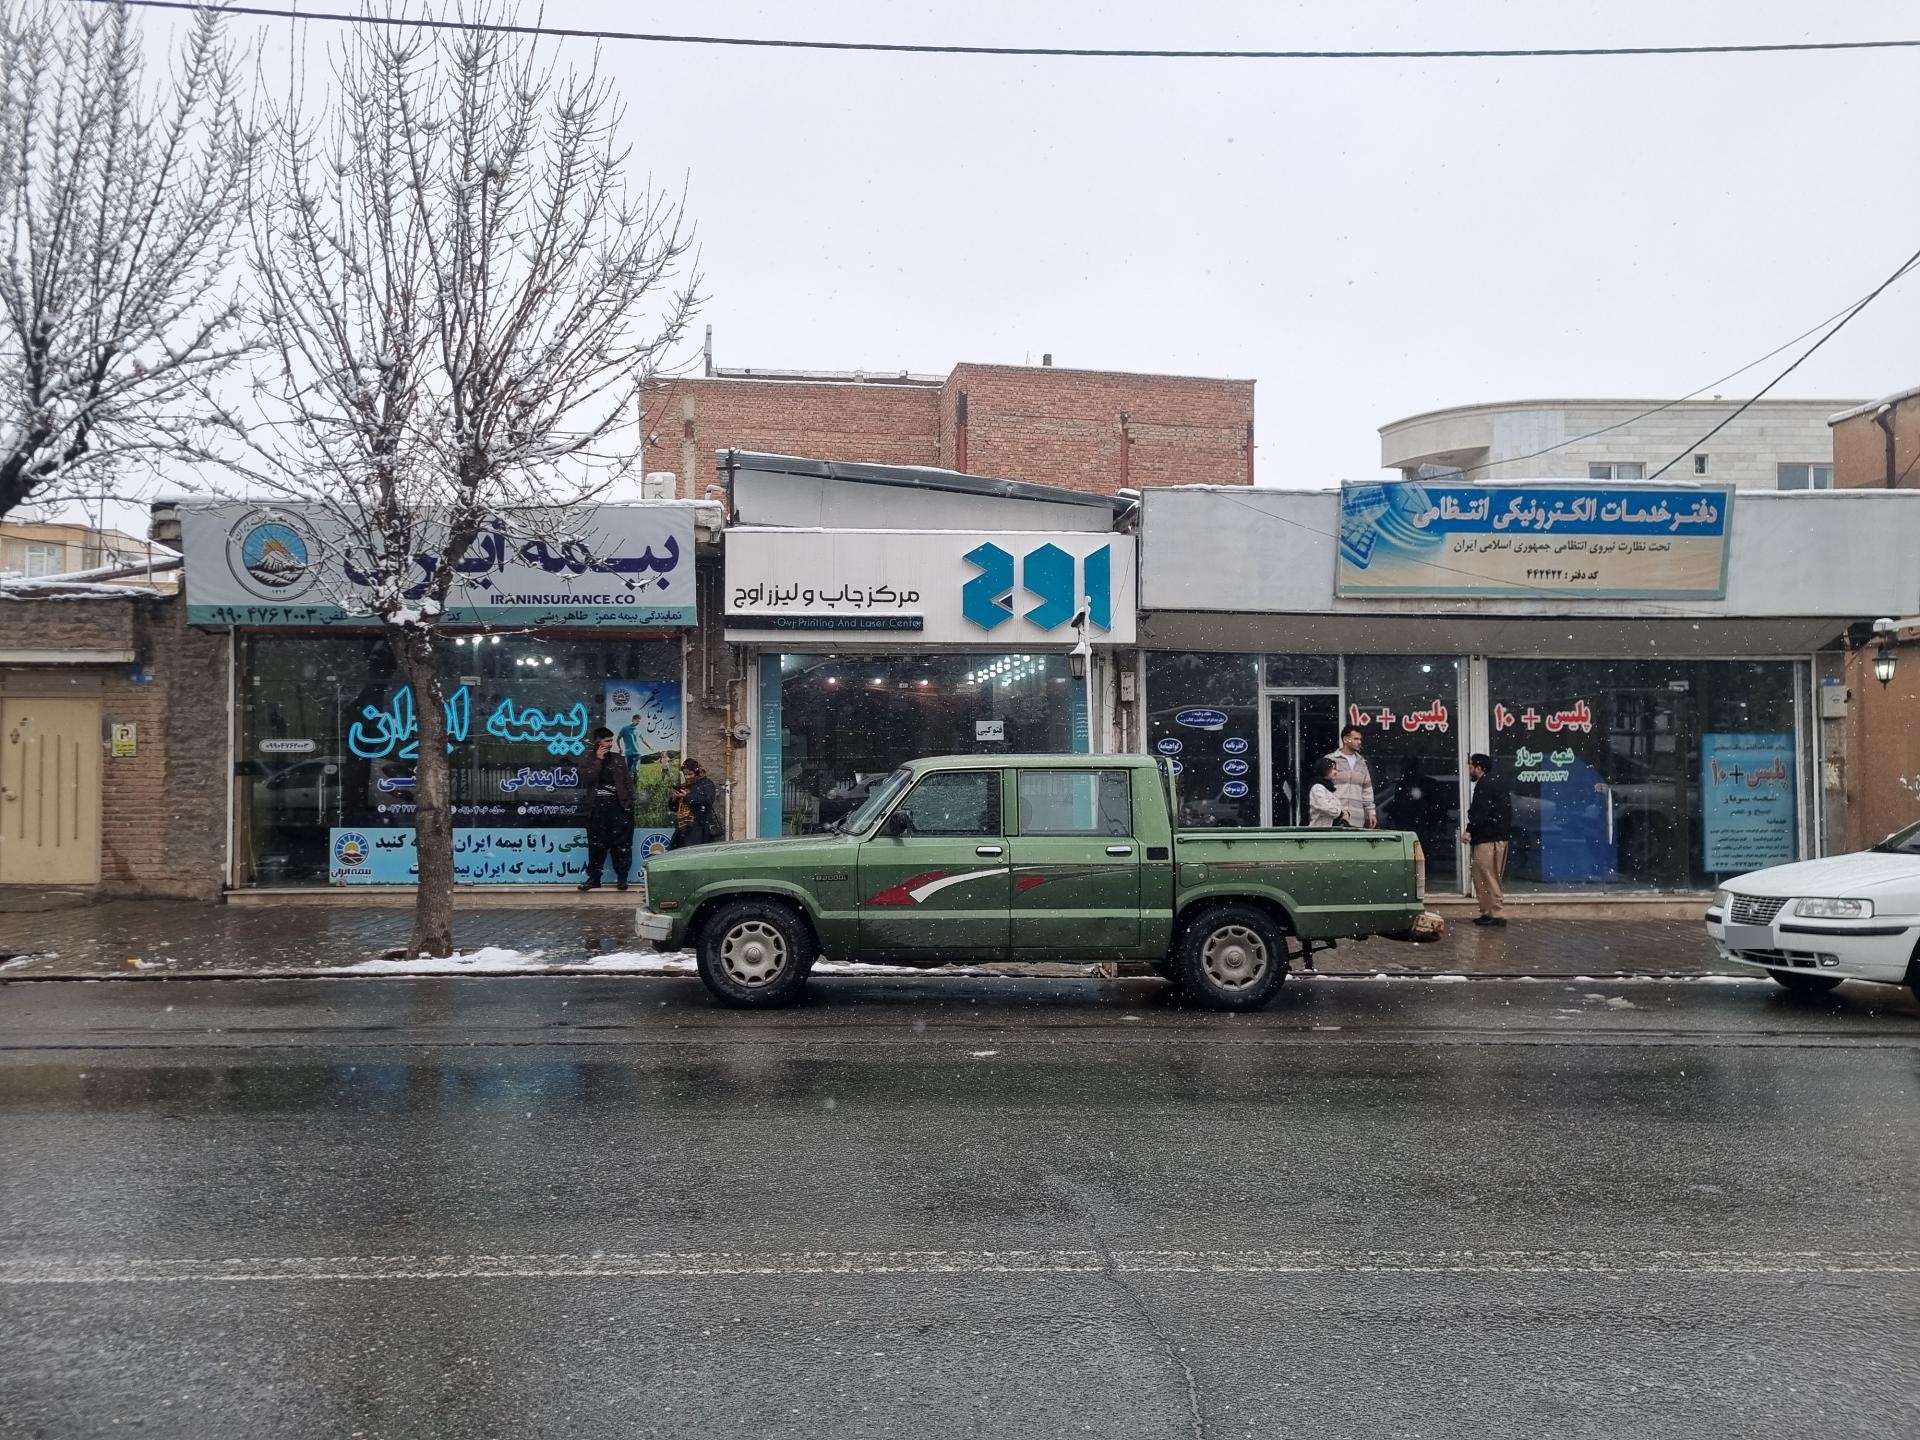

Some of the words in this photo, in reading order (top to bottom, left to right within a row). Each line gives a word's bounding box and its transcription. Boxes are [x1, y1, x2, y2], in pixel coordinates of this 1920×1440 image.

[1413, 496, 1490, 529] انتظامی
[1493, 496, 1598, 530] الکترونیکی
[1601, 498, 1671, 523] خدمات
[1668, 499, 1718, 531] دفتر
[1453, 539, 1477, 552] ایران
[1479, 540, 1512, 553] اسلامی
[1514, 542, 1551, 554] جمهوری
[1554, 540, 1588, 554] انتظامی
[1589, 542, 1616, 554] نیروی
[1618, 541, 1646, 554] نظارت
[1648, 542, 1671, 551] تحت
[520, 534, 680, 592] بیمه
[1587, 570, 1600, 580] کد
[490, 593, 636, 605] IRANINSURANCE.CO
[734, 582, 764, 608] اوج
[767, 583, 798, 606] لیزر
[802, 588, 814, 607] و
[819, 584, 864, 608] چاپ
[867, 585, 920, 608] مرکز
[211, 608, 242, 623] ۰۹۹۰
[249, 607, 279, 623] ۴۷۶
[285, 608, 317, 623] ۲۰۰۳
[618, 611, 638, 623] بیمه
[639, 610, 682, 625] نمایندگی
[799, 617, 834, 628] Printing
[838, 618, 857, 627] And
[860, 618, 886, 627] Laser
[889, 618, 922, 627] Center
[1349, 703, 1371, 726] ۱۰
[1401, 699, 1449, 733] پلیس
[1494, 703, 1516, 731] ۱۰
[1545, 699, 1593, 733] پلیس
[486, 697, 588, 756] بیمه
[1514, 746, 1543, 767] سرباز
[1550, 747, 1575, 767] شعبه
[500, 767, 579, 792] نمایندگی
[1711, 758, 1727, 786] ۱۰
[1746, 756, 1789, 789] پلیس
[375, 834, 407, 852] کنید
[454, 834, 491, 854] ایران
[496, 836, 522, 852] بیمه
[541, 835, 555, 853] را
[330, 868, 351, 879] ایران
[350, 868, 372, 879] بیمه
[454, 865, 470, 879] بیم
[473, 861, 503, 878] ایران
[508, 861, 523, 875] که
[526, 862, 553, 876] است
[557, 862, 580, 878] سال
